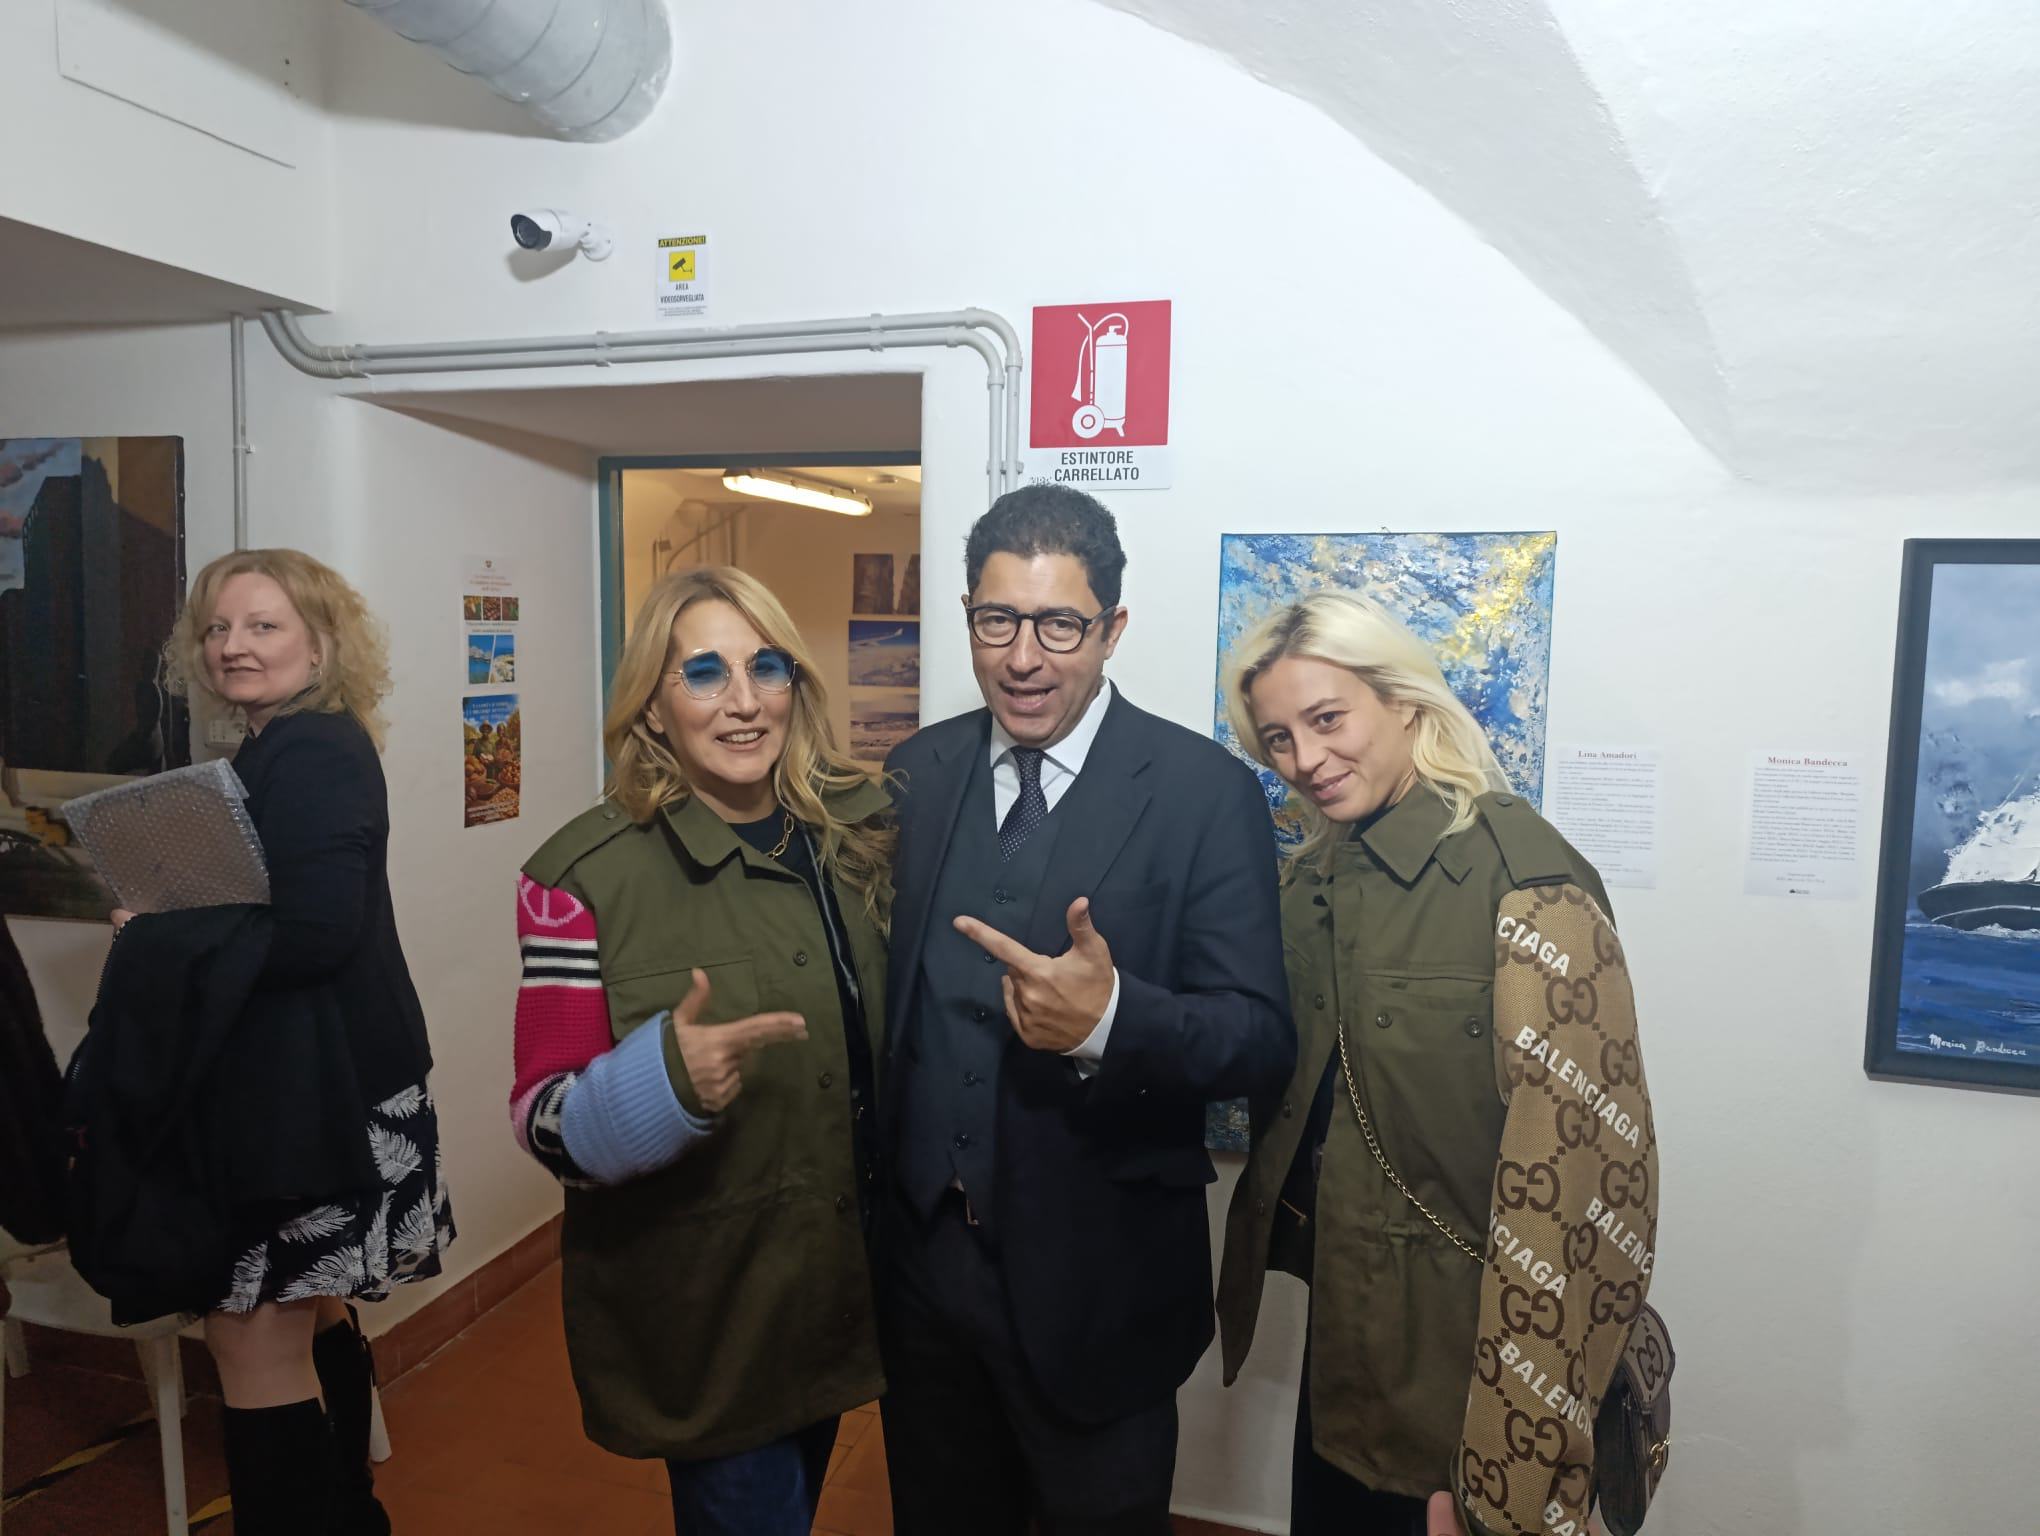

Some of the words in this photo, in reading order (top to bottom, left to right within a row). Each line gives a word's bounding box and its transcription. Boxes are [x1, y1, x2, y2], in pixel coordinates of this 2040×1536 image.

[675, 282, 689, 290] AREA
[660, 293, 705, 304] VIDEOSORVEGLIATA
[1061, 451, 1134, 465] ESTINTORE
[1054, 467, 1140, 482] CARRELLATO
[1768, 757, 1801, 765] Monica
[1515, 1025, 1640, 1149] BALENCIAGA
